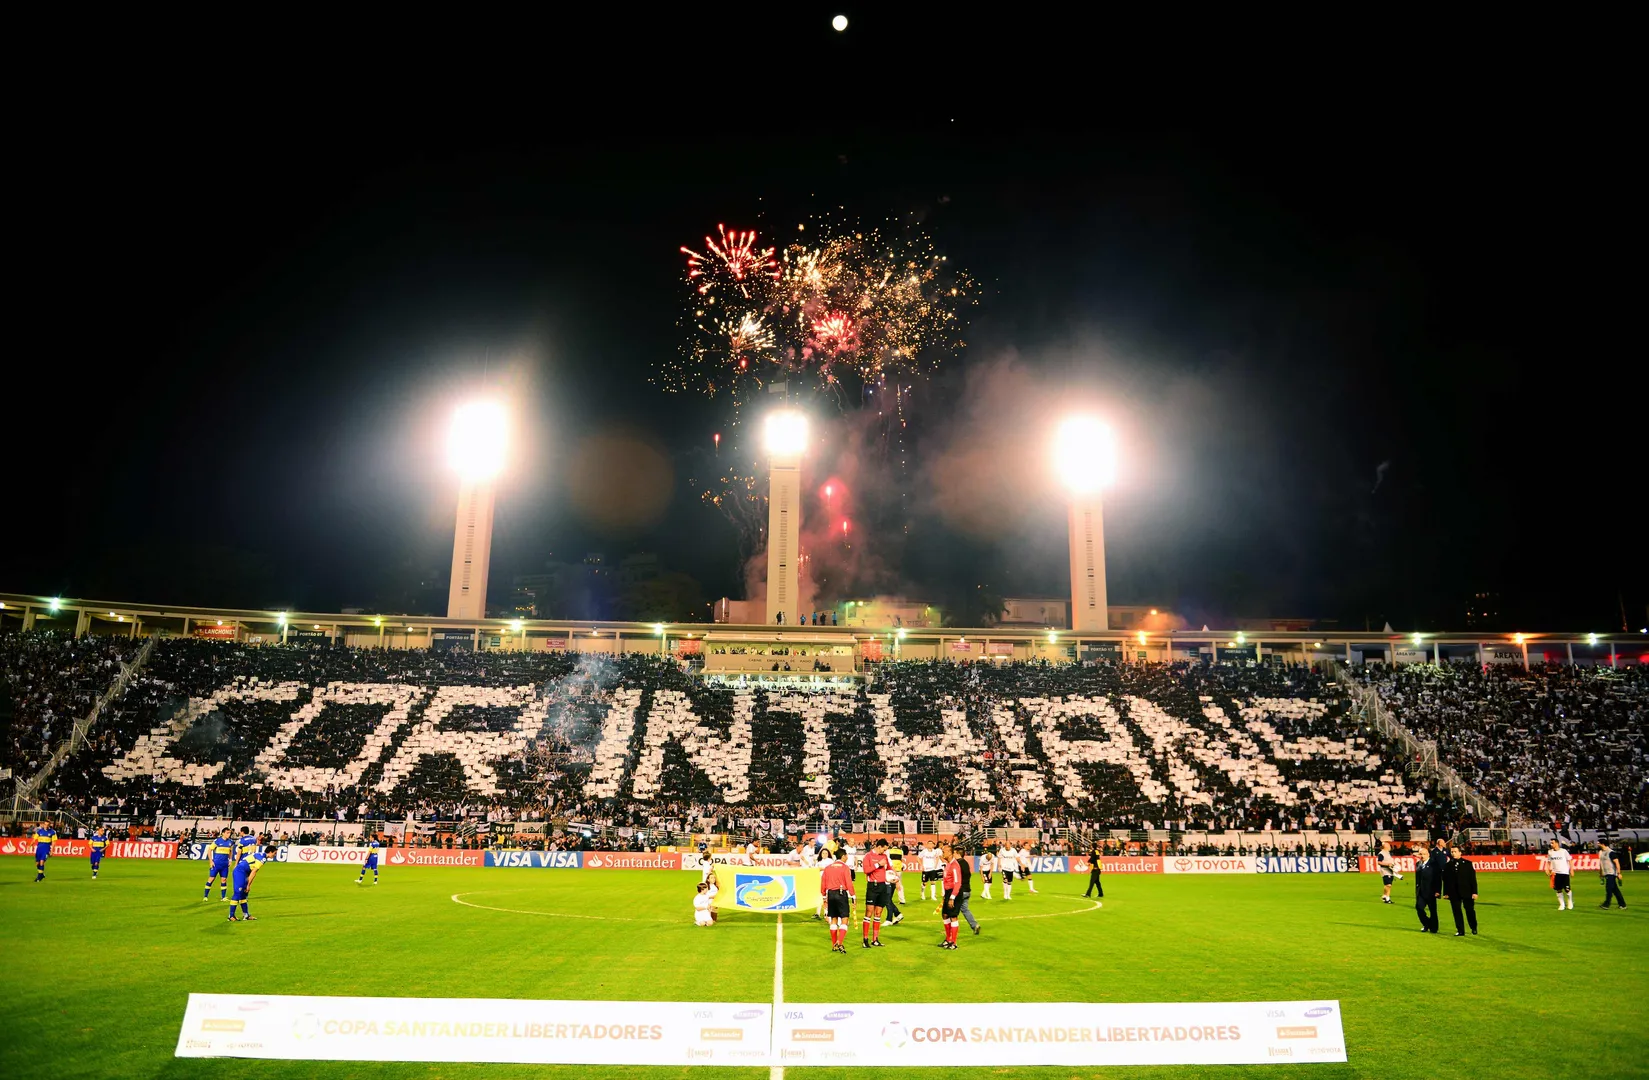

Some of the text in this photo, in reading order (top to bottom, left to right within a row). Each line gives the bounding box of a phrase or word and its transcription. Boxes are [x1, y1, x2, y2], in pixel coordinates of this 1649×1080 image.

[321, 850, 367, 861] TOYOT
[407, 851, 478, 866] Santander
[490, 851, 579, 868] VISA VISA
[605, 854, 676, 869] Santander
[1194, 859, 1246, 870] TOYOTA
[1256, 857, 1348, 873] SAMSUNG
[693, 1010, 714, 1019] VISA
[784, 1011, 804, 1020] VISA
[1266, 1009, 1286, 1018] VISA
[323, 1020, 663, 1041] COPA SANTANDER LIBERTADORES
[710, 1030, 741, 1038] Santander
[801, 1031, 833, 1039] Santander
[911, 1025, 1241, 1043] COPA SANTANDER LIBERTADORES
